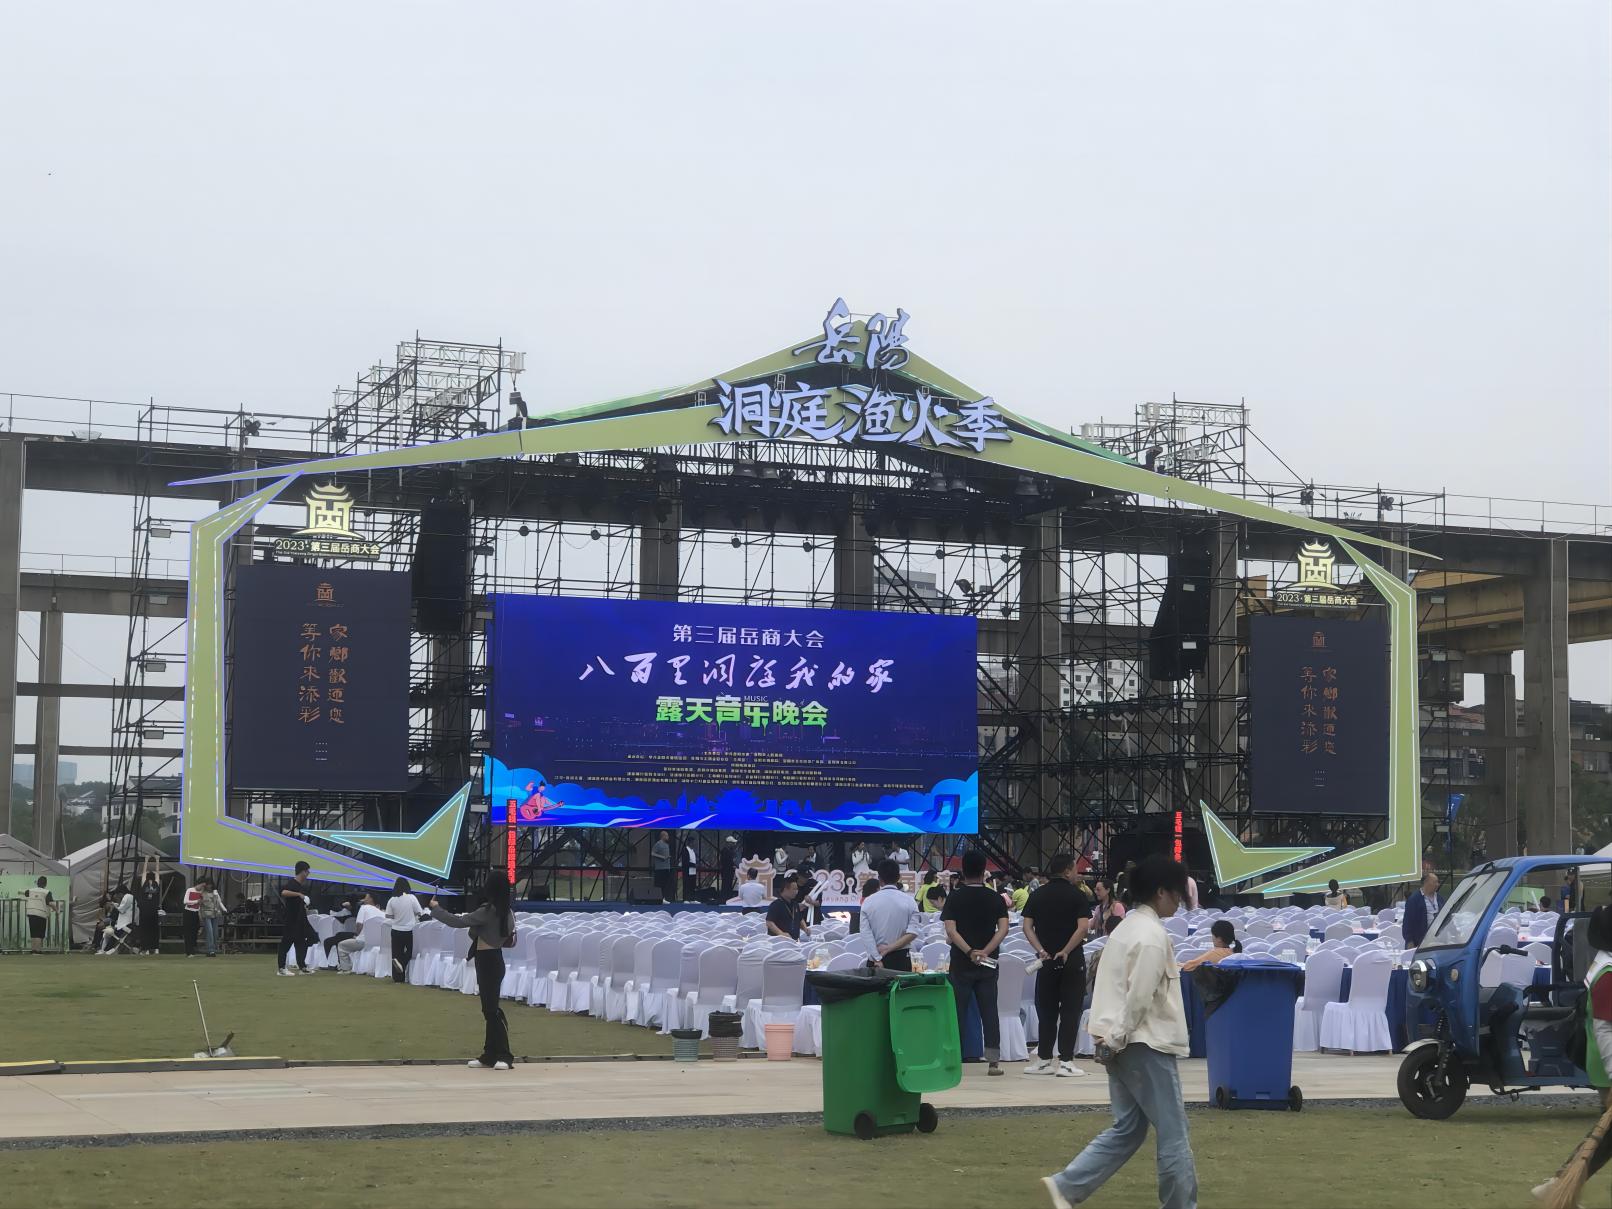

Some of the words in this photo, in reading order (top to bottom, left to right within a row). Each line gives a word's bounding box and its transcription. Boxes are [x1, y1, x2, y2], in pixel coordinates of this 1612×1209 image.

[673, 624, 824, 648] 第三届岳商大会
[743, 695, 768, 703] MUSIC
[656, 694, 829, 729] 露天音乐晚会
